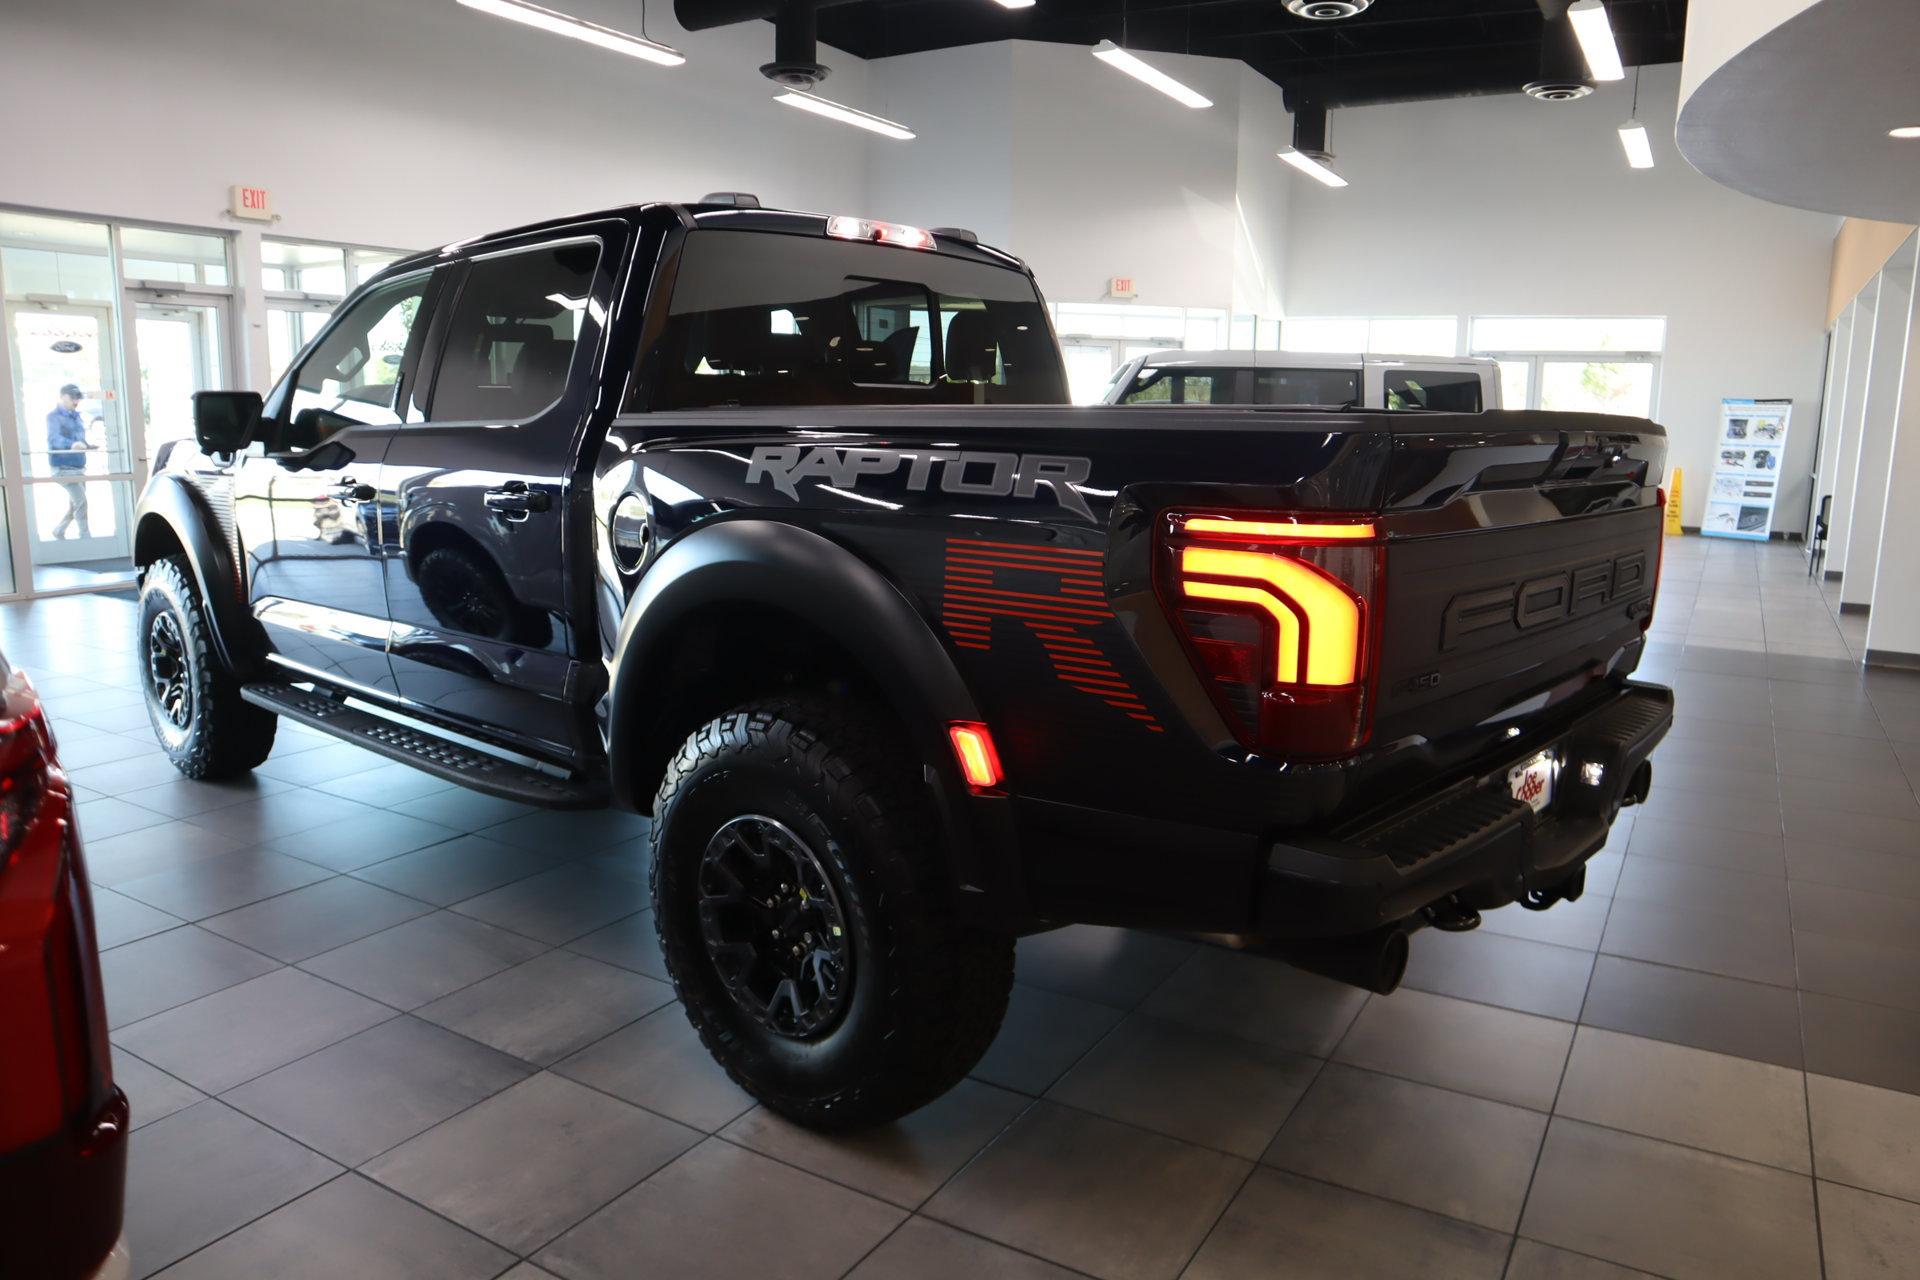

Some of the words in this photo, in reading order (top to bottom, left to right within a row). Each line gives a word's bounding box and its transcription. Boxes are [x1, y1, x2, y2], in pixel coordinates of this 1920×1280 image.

[242, 188, 266, 210] EXIT
[1115, 279, 1131, 291] EXIT
[745, 446, 1098, 524] RAPTOR
[1439, 550, 1646, 653] FORD
[1515, 779, 1545, 802] Cooper
[1522, 770, 1538, 791] Joe
